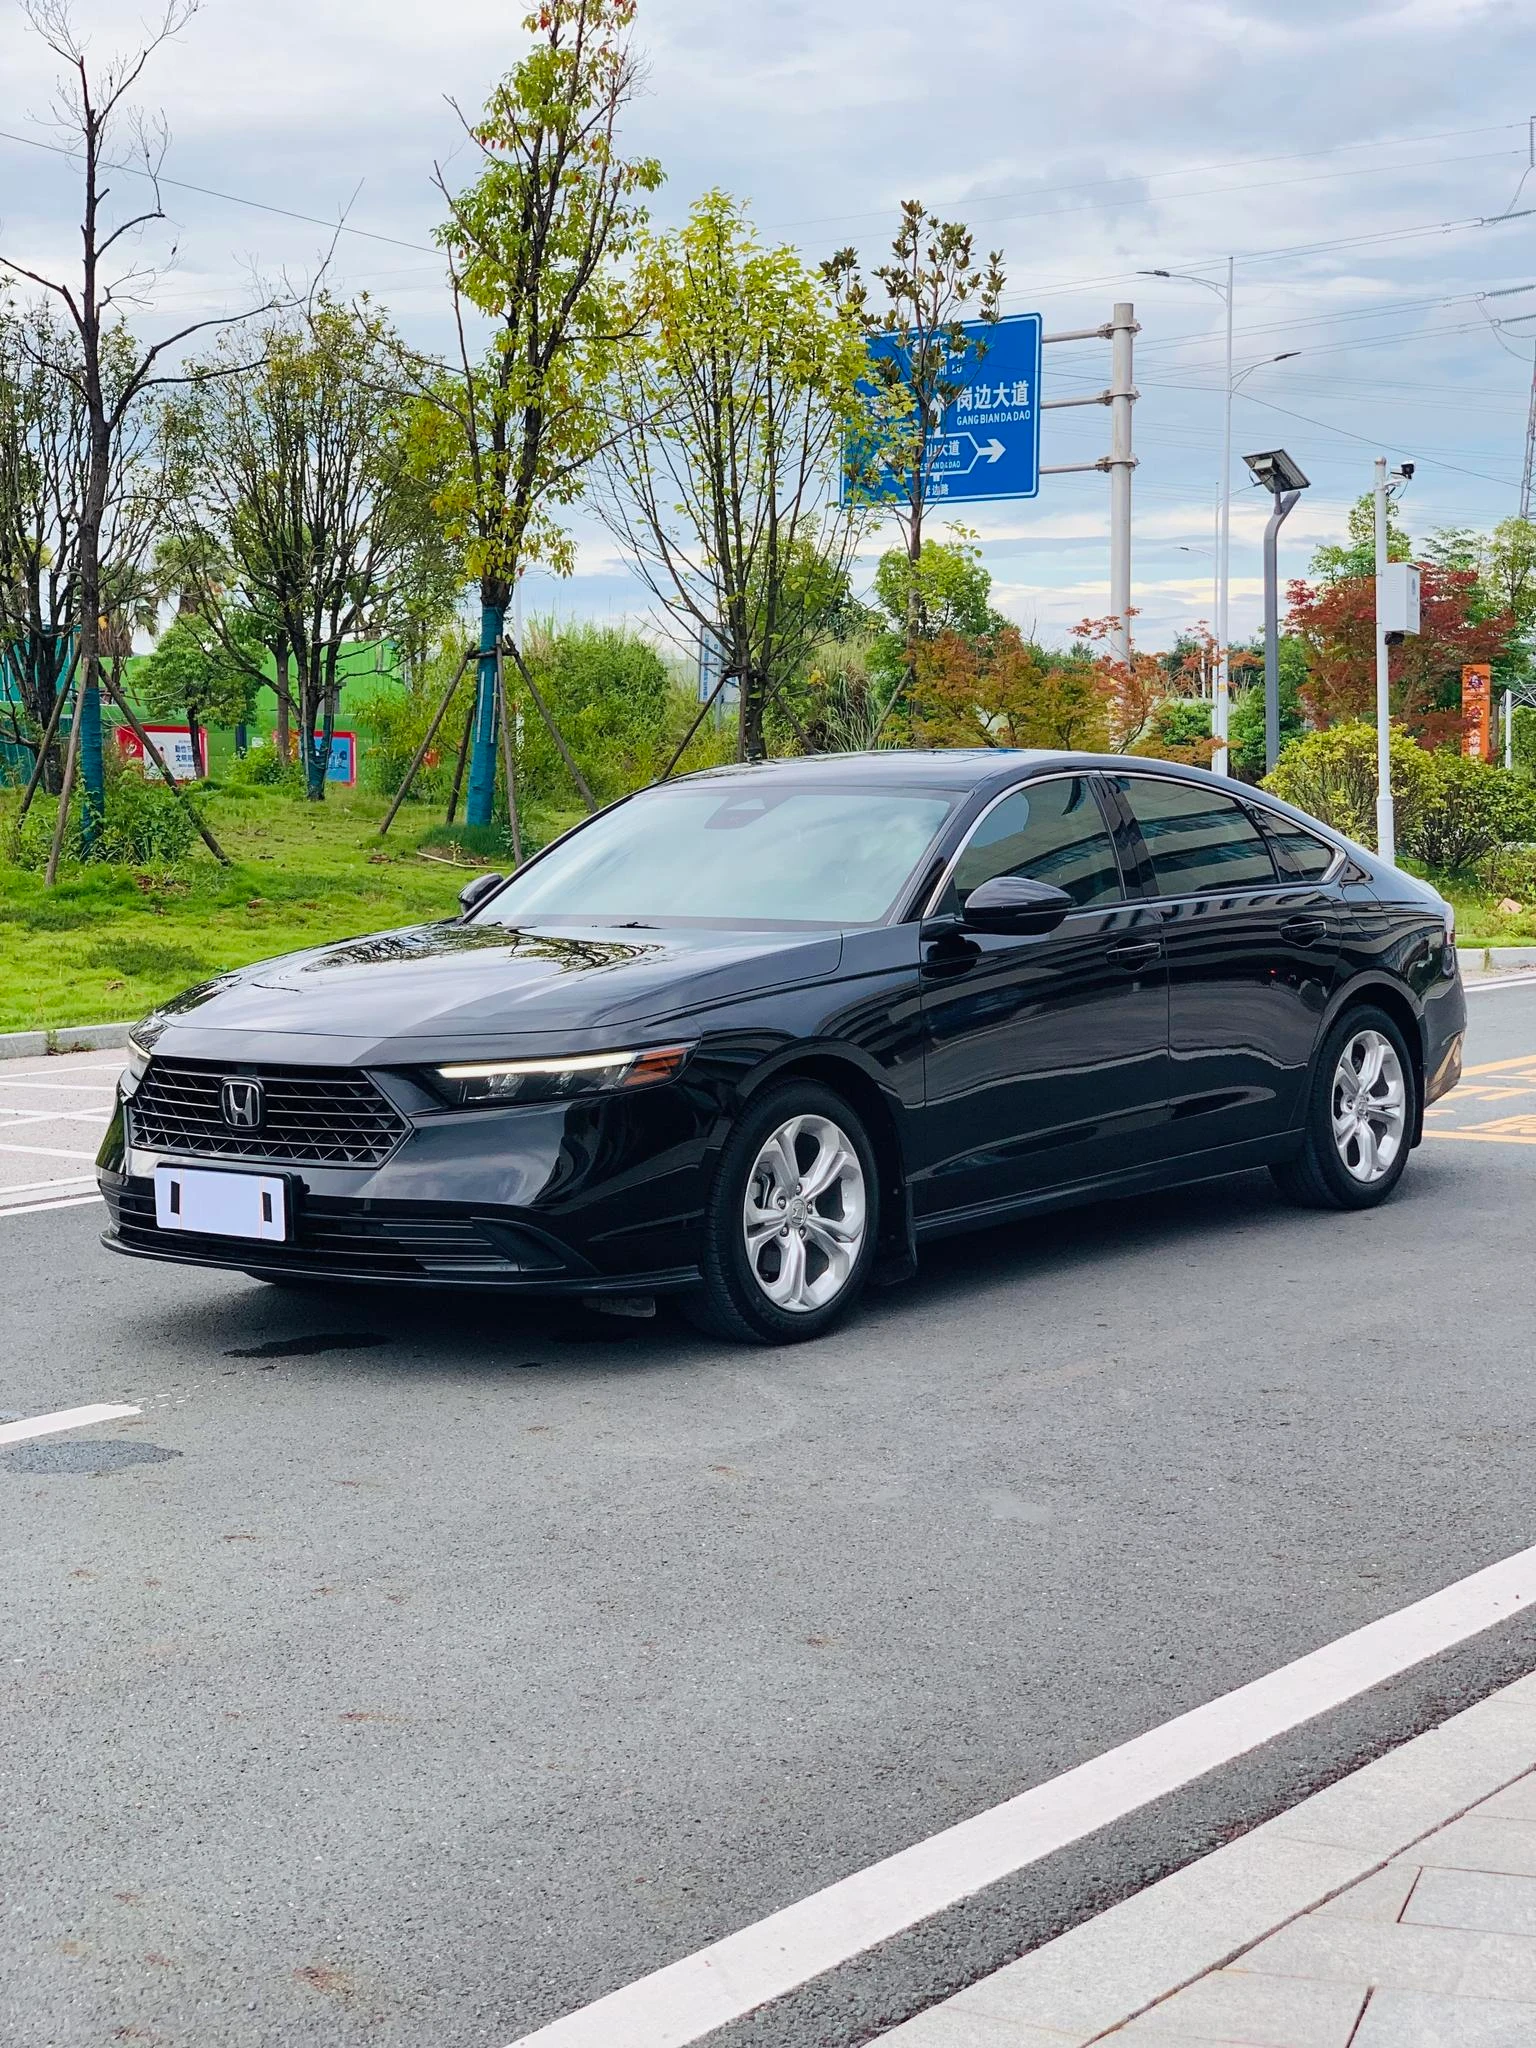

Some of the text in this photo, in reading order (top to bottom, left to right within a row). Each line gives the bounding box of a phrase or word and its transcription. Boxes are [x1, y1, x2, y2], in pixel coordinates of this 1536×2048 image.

[956, 379, 1030, 413] 岗边大道
[926, 439, 961, 458] 山大道
